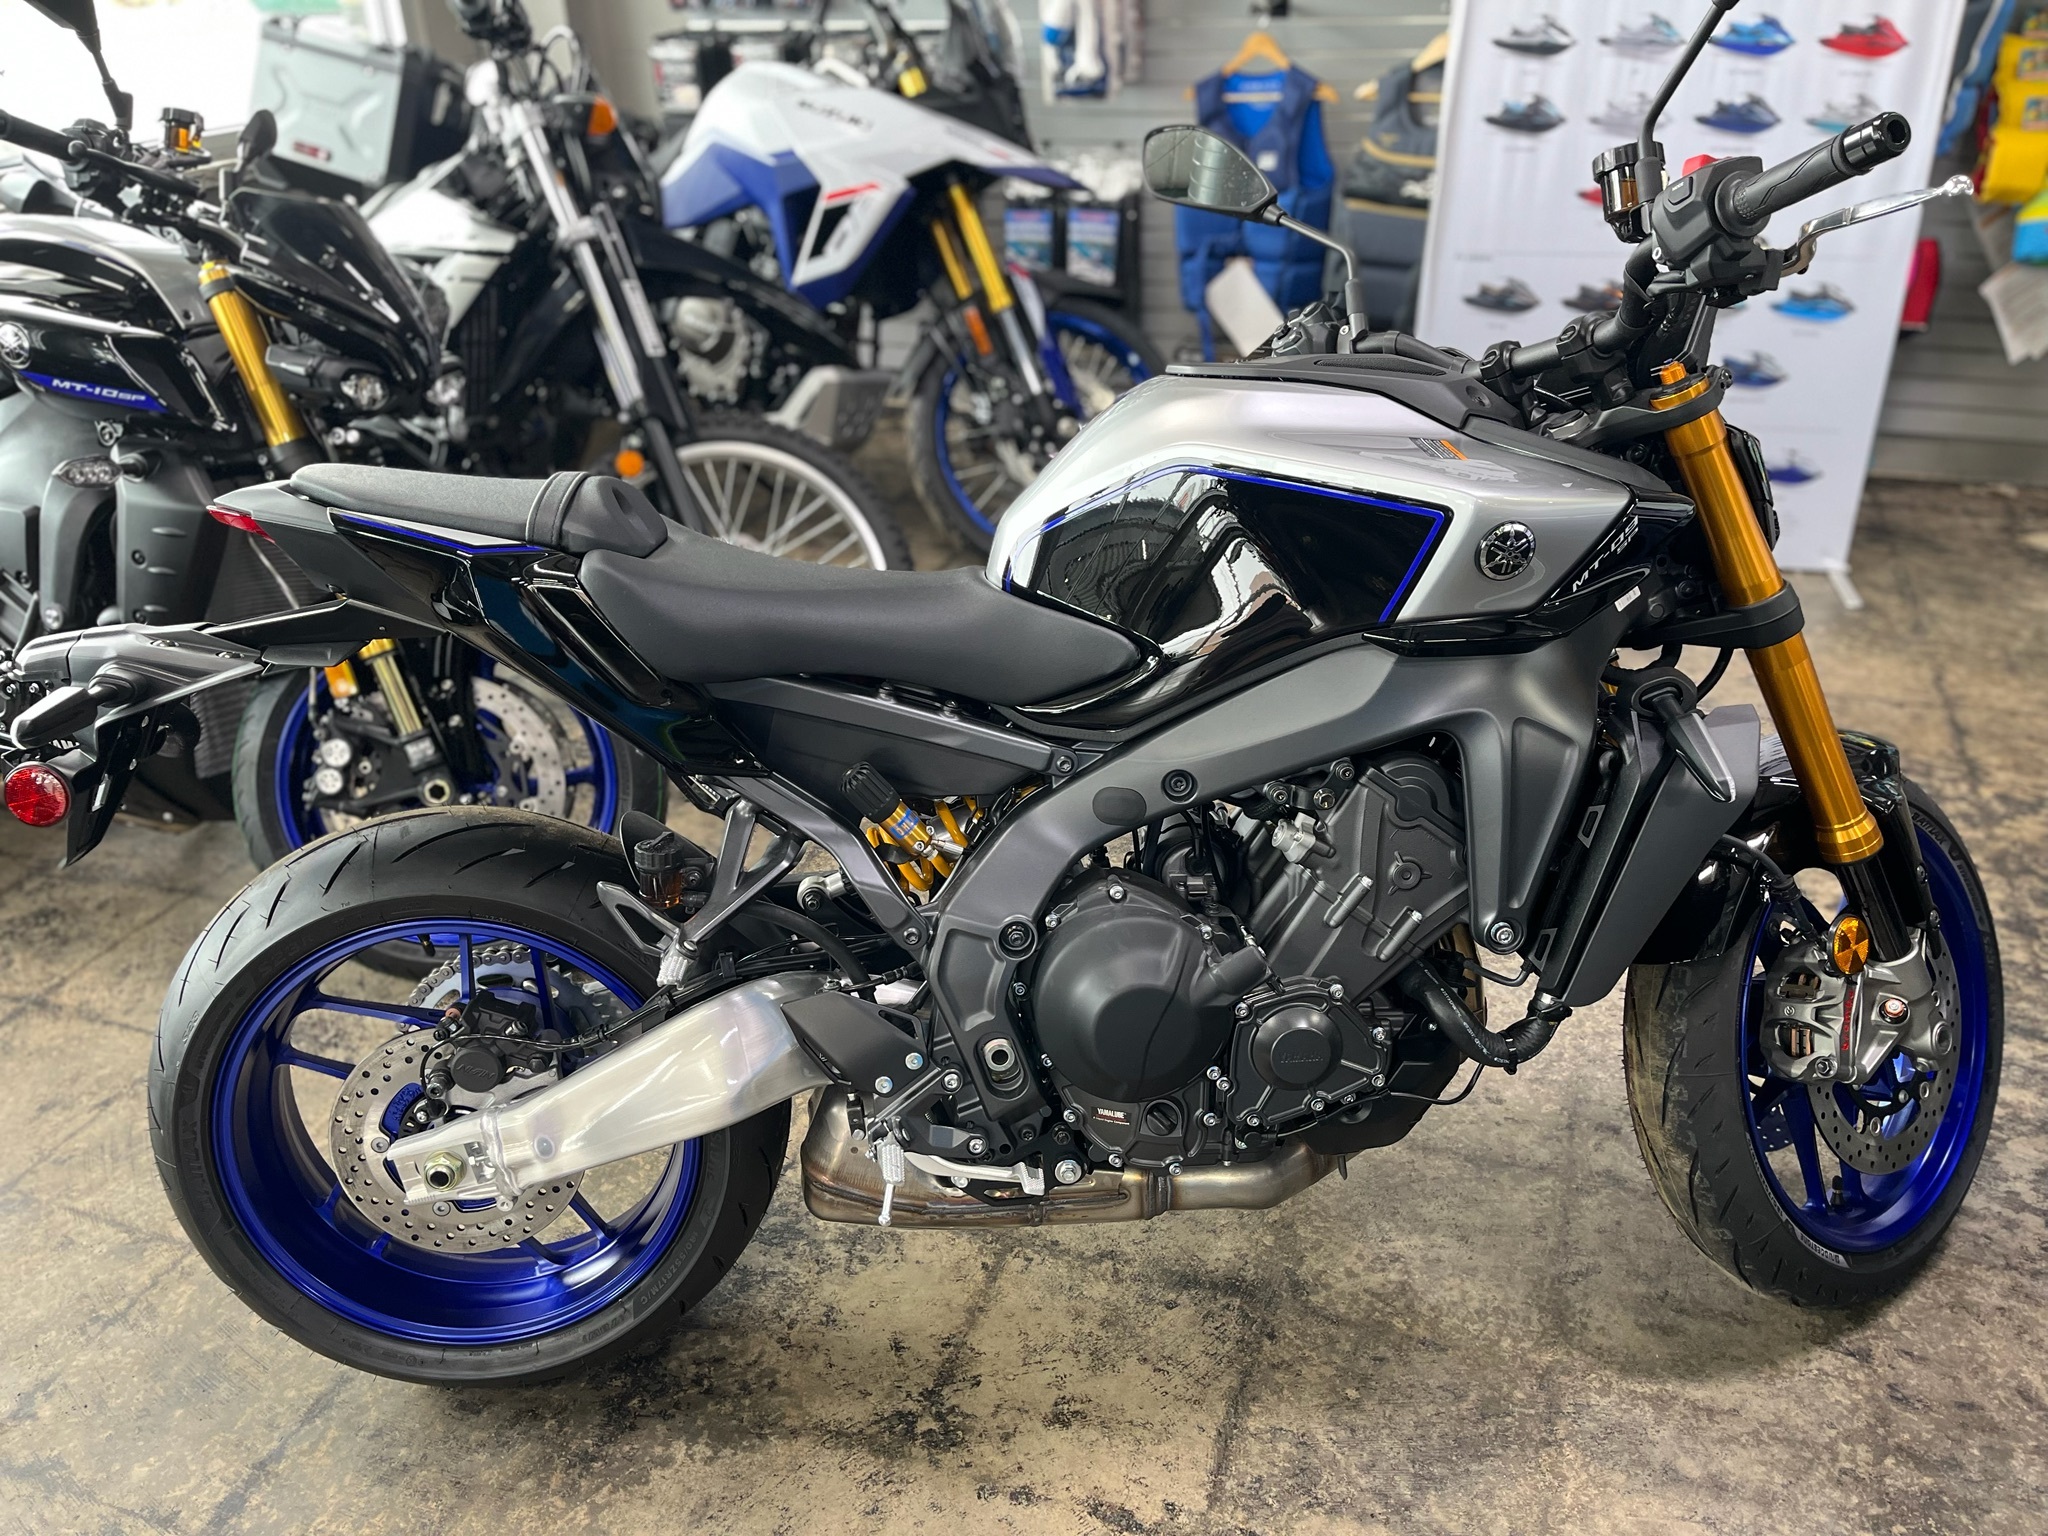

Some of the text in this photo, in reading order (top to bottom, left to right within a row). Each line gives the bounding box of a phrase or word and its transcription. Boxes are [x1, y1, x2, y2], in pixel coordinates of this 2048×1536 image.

[1572, 515, 1639, 593] MT-09
[1911, 812, 1947, 845] BATTLAX
[456, 1063, 496, 1079] NISSIN
